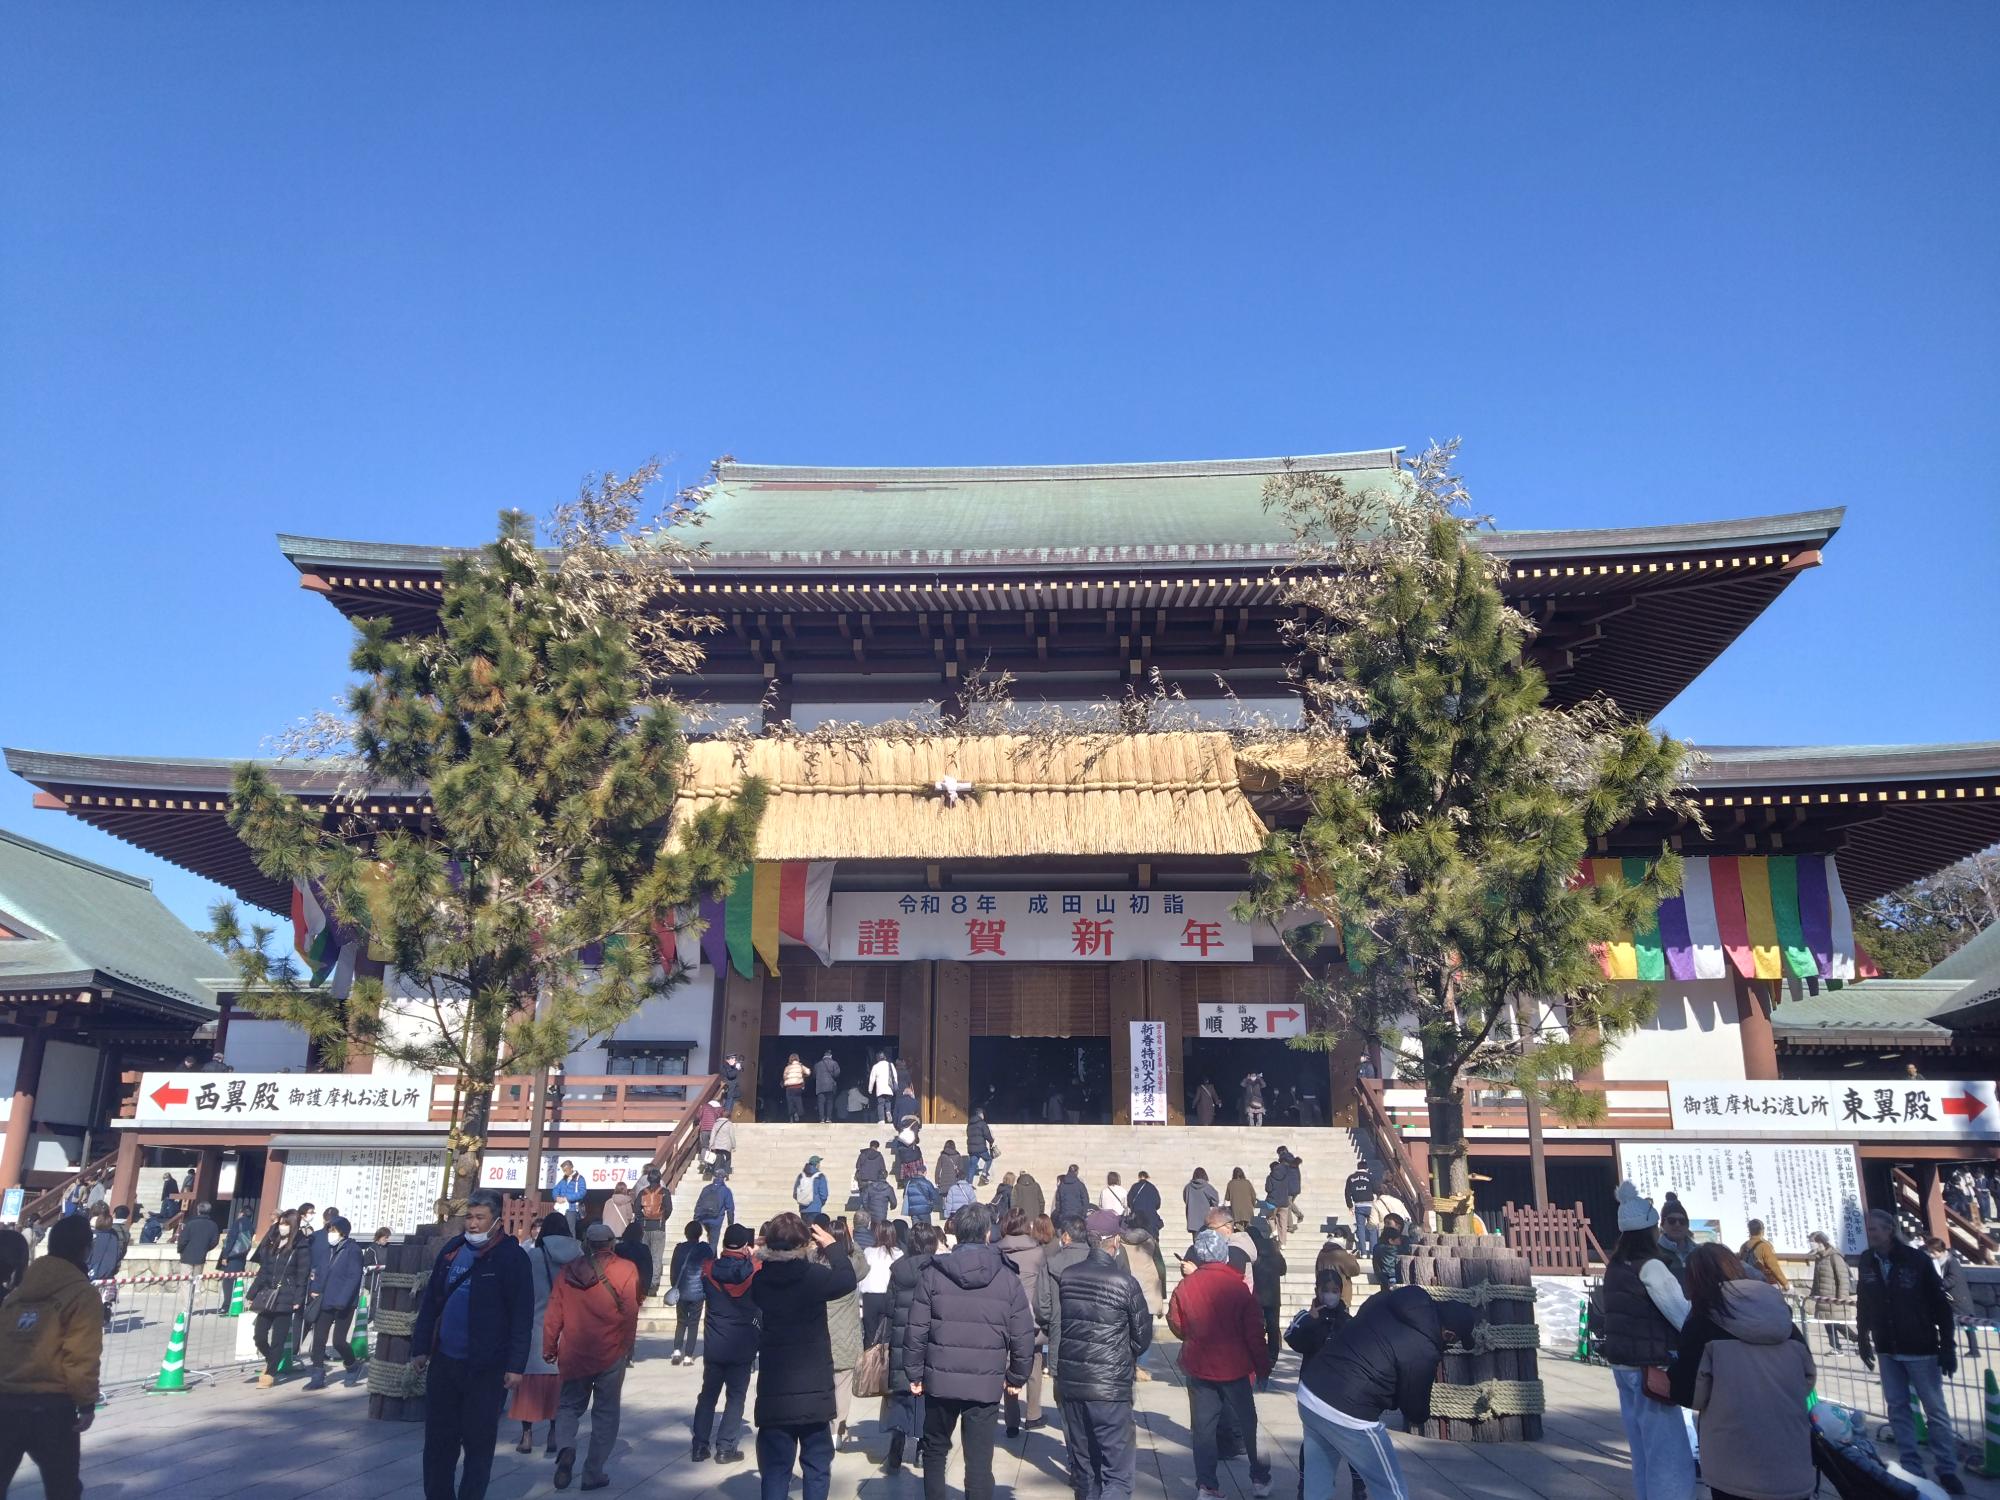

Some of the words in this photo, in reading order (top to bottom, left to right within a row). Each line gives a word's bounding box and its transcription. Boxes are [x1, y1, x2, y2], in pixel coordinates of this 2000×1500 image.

[898, 894, 997, 915] 令和8年
[1028, 894, 1185, 915] 成田山初詣
[857, 918, 1224, 957] 謹賀新年
[825, 1014, 877, 1033] 順路
[1205, 1016, 1258, 1034] 順路
[1140, 1023, 1156, 1117] 新春特別大祈祷会
[196, 1080, 279, 1112] 西翼殿
[288, 1087, 420, 1108] 御護摩札お渡し所
[1683, 1094, 1829, 1117] 御護摩札お渡し所
[1842, 1087, 1937, 1123] 東翼殿
